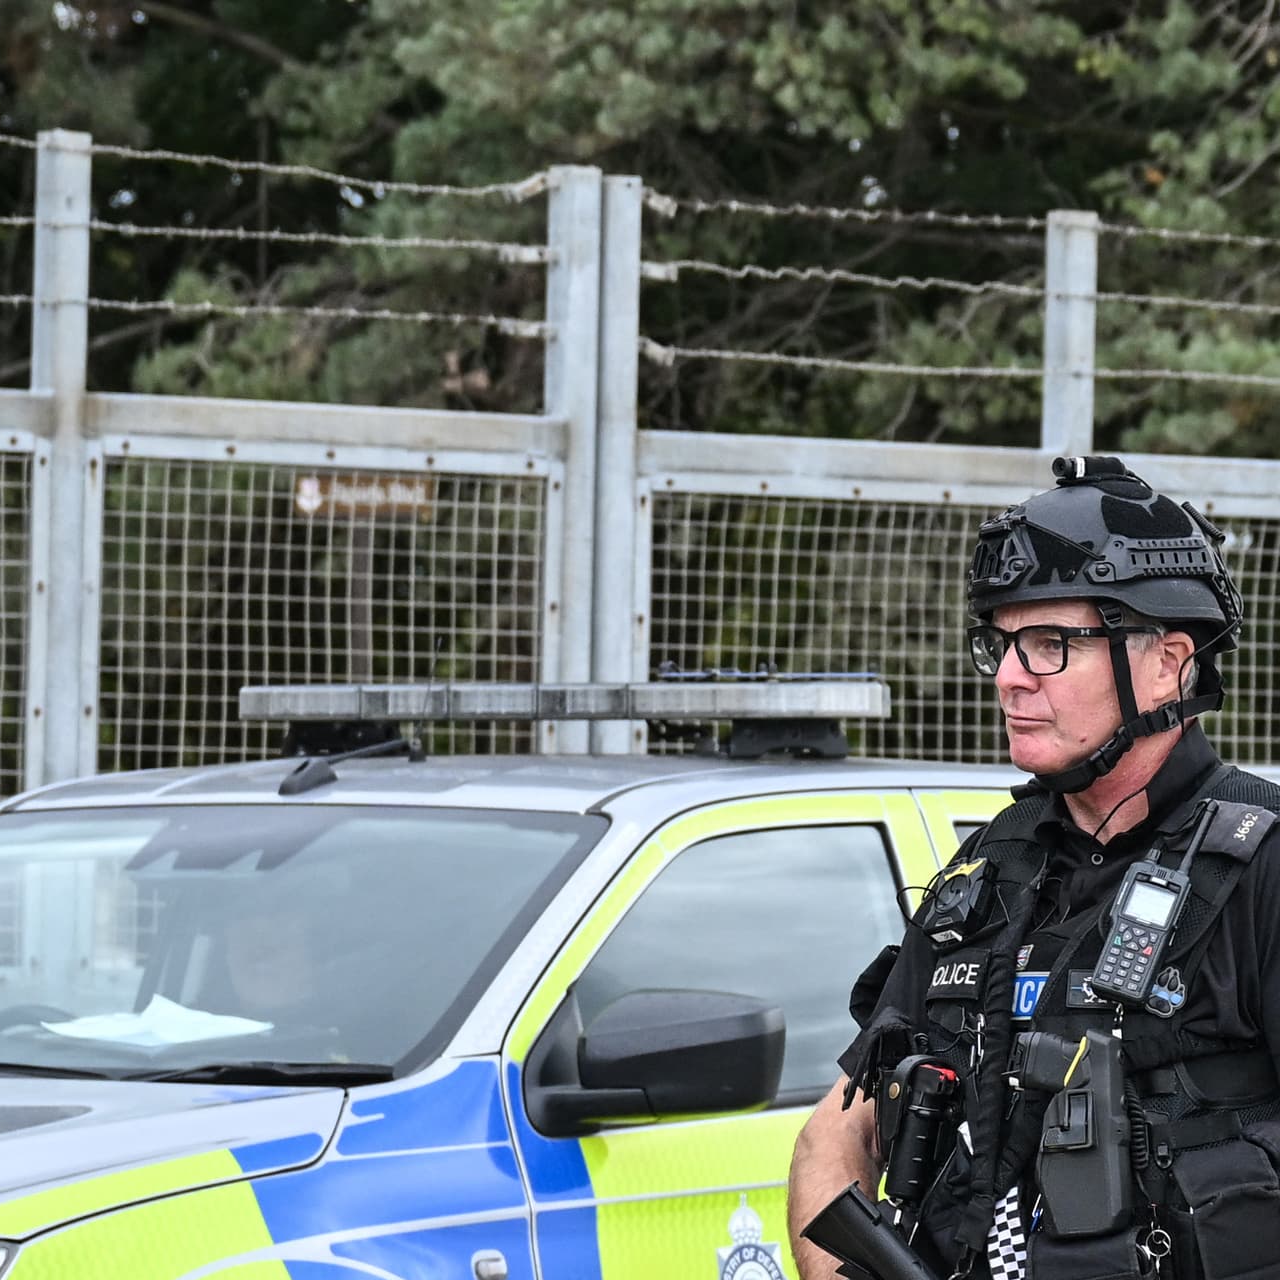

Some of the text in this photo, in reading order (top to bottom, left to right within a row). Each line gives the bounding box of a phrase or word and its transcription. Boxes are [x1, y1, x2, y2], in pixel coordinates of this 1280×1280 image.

[1233, 812, 1259, 841] 3662
[931, 963, 981, 986] OLICE
[742, 1247, 755, 1260] OF
